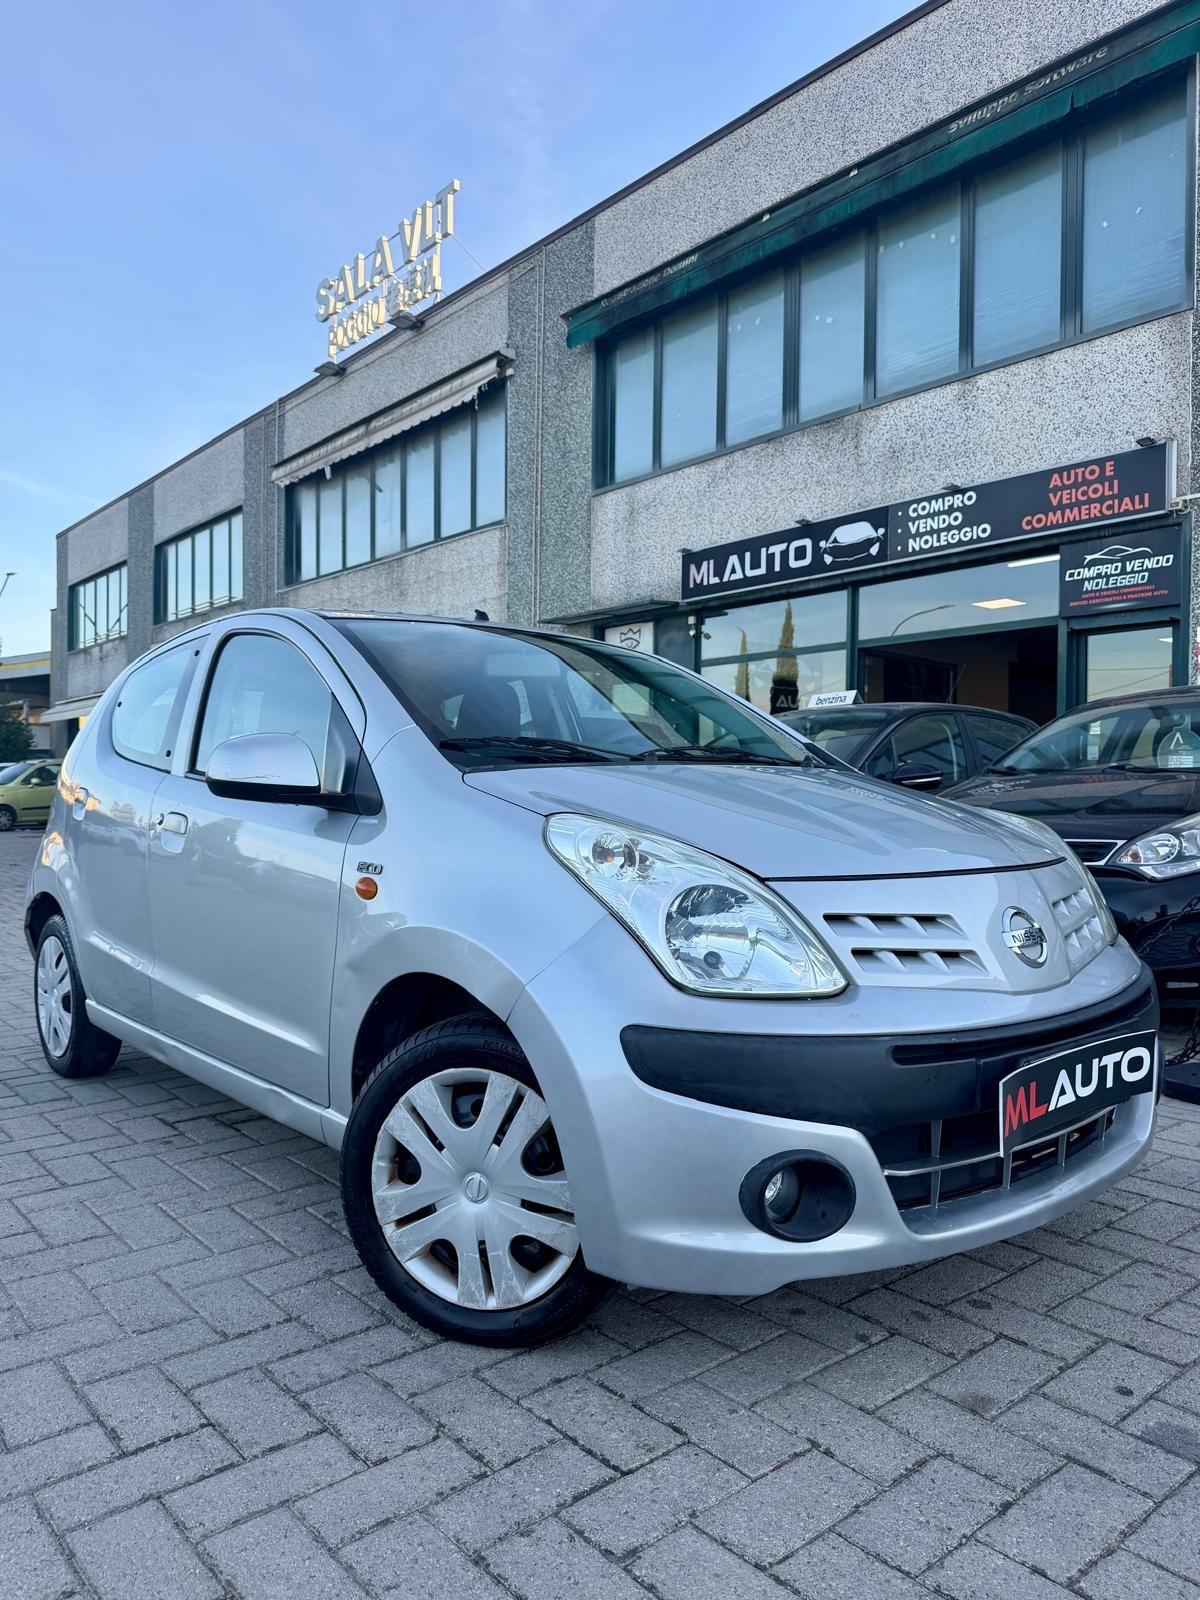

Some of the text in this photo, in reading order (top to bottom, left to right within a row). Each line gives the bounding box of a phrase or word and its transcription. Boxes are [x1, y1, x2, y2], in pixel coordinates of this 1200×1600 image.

[315, 235, 395, 323] SALA
[1049, 460, 1115, 489] AUTO E
[908, 491, 977, 518] COMPRO
[1049, 480, 1119, 506] VEICOLI
[908, 512, 963, 535] VENDO
[1021, 493, 1149, 531] COMMERCIALI
[908, 523, 992, 552] NOLEGGIO
[1065, 554, 1174, 581] COMPRO VENDO
[1083, 572, 1149, 592] NOLEGGIO
[815, 694, 847, 706] benzina
